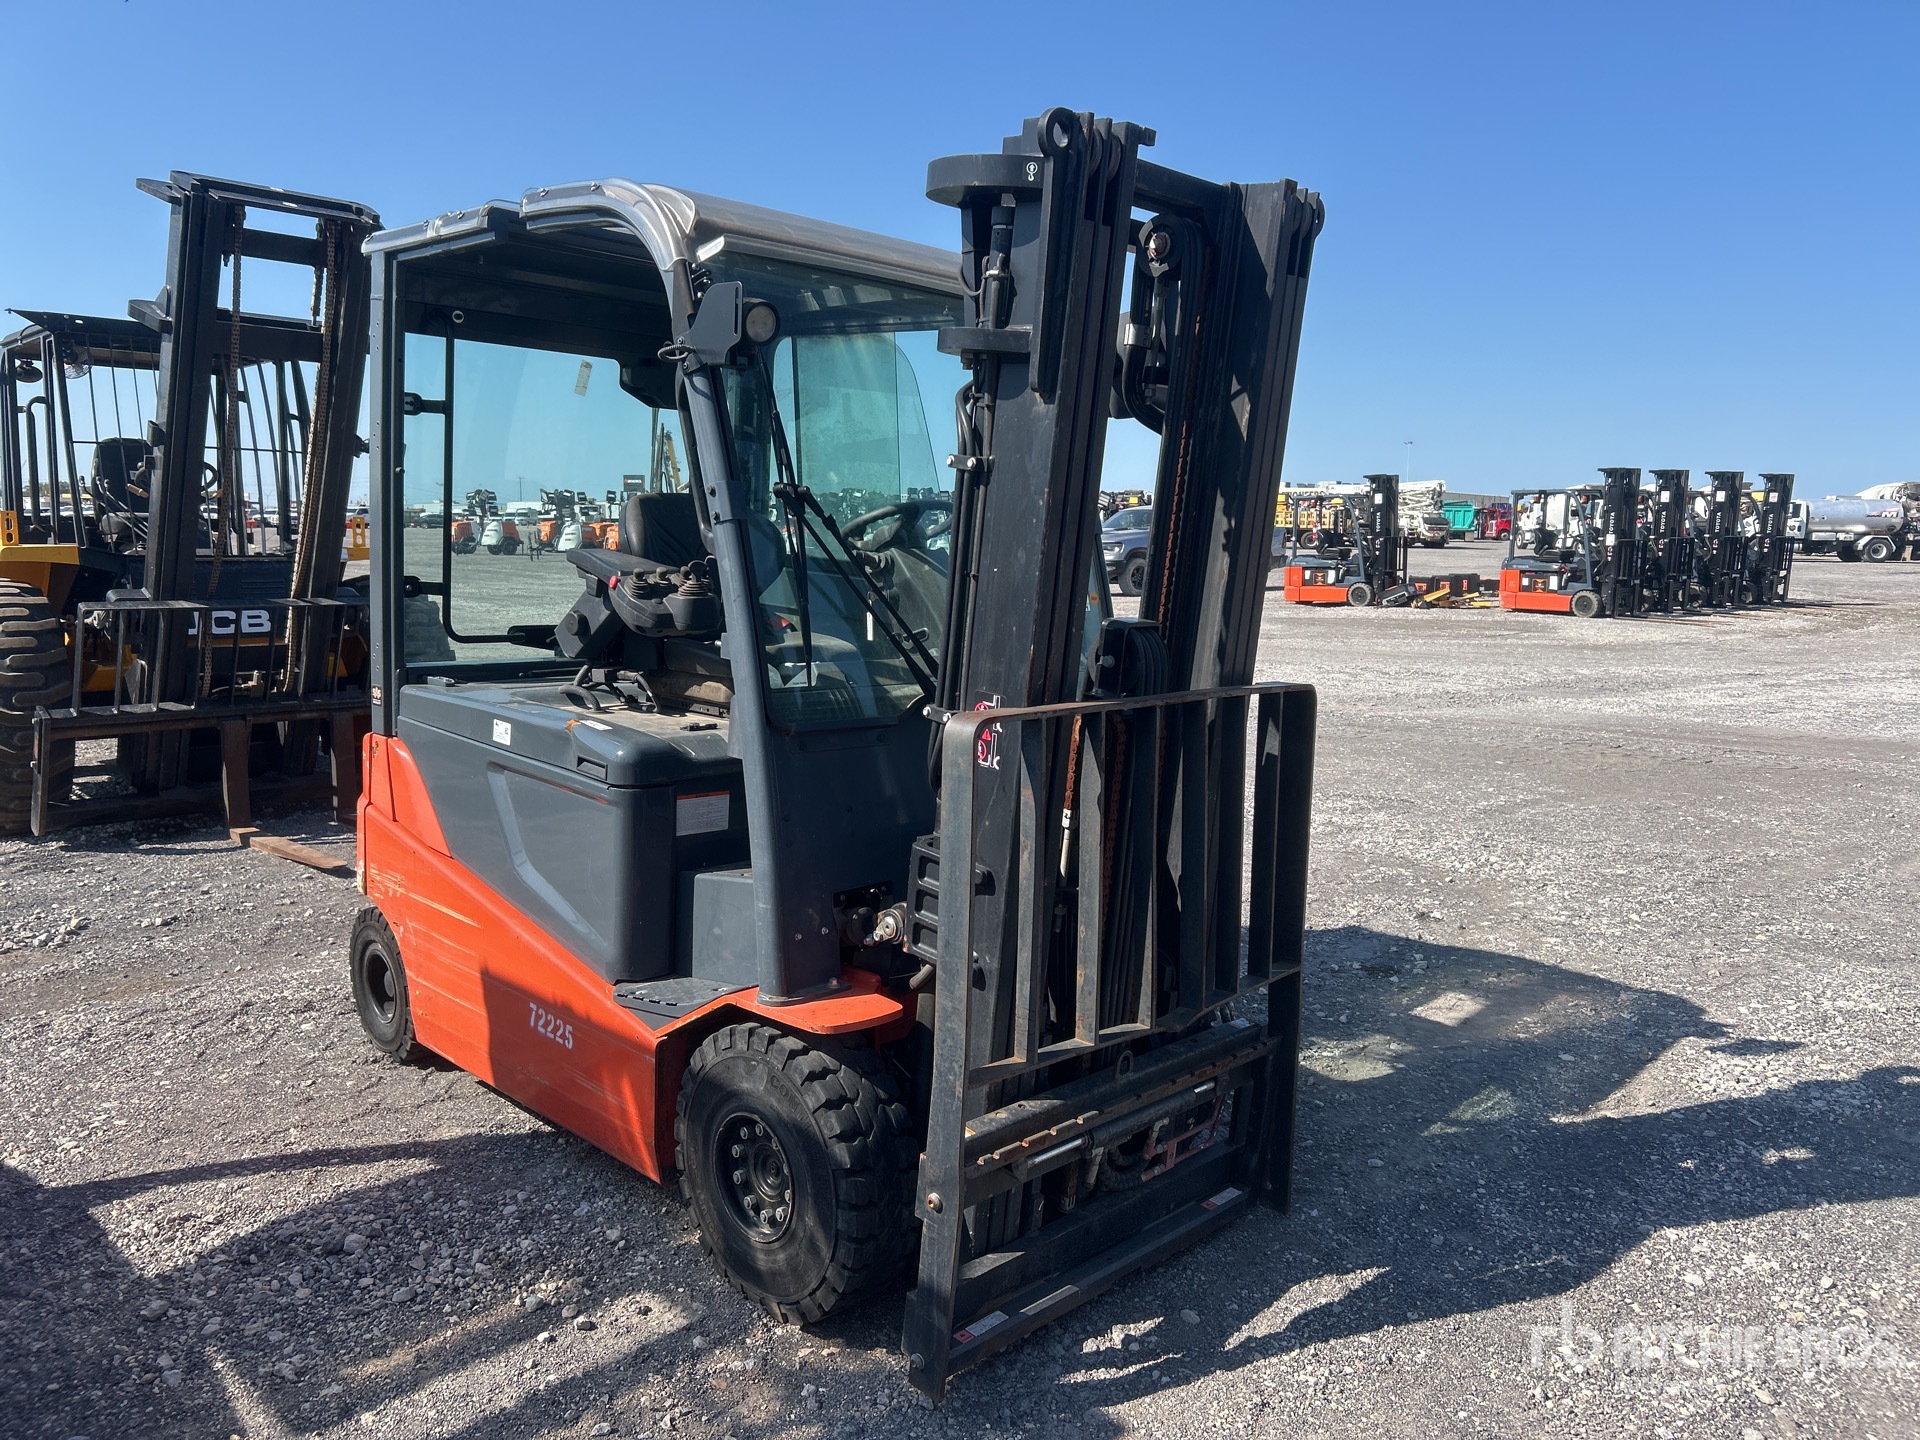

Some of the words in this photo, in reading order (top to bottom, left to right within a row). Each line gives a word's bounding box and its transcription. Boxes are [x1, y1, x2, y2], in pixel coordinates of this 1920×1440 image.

[1714, 512, 1722, 533] TOYOTA
[1766, 513, 1774, 534] TOYOTA
[188, 610, 272, 635] JCB
[529, 1002, 573, 1050] 72225
